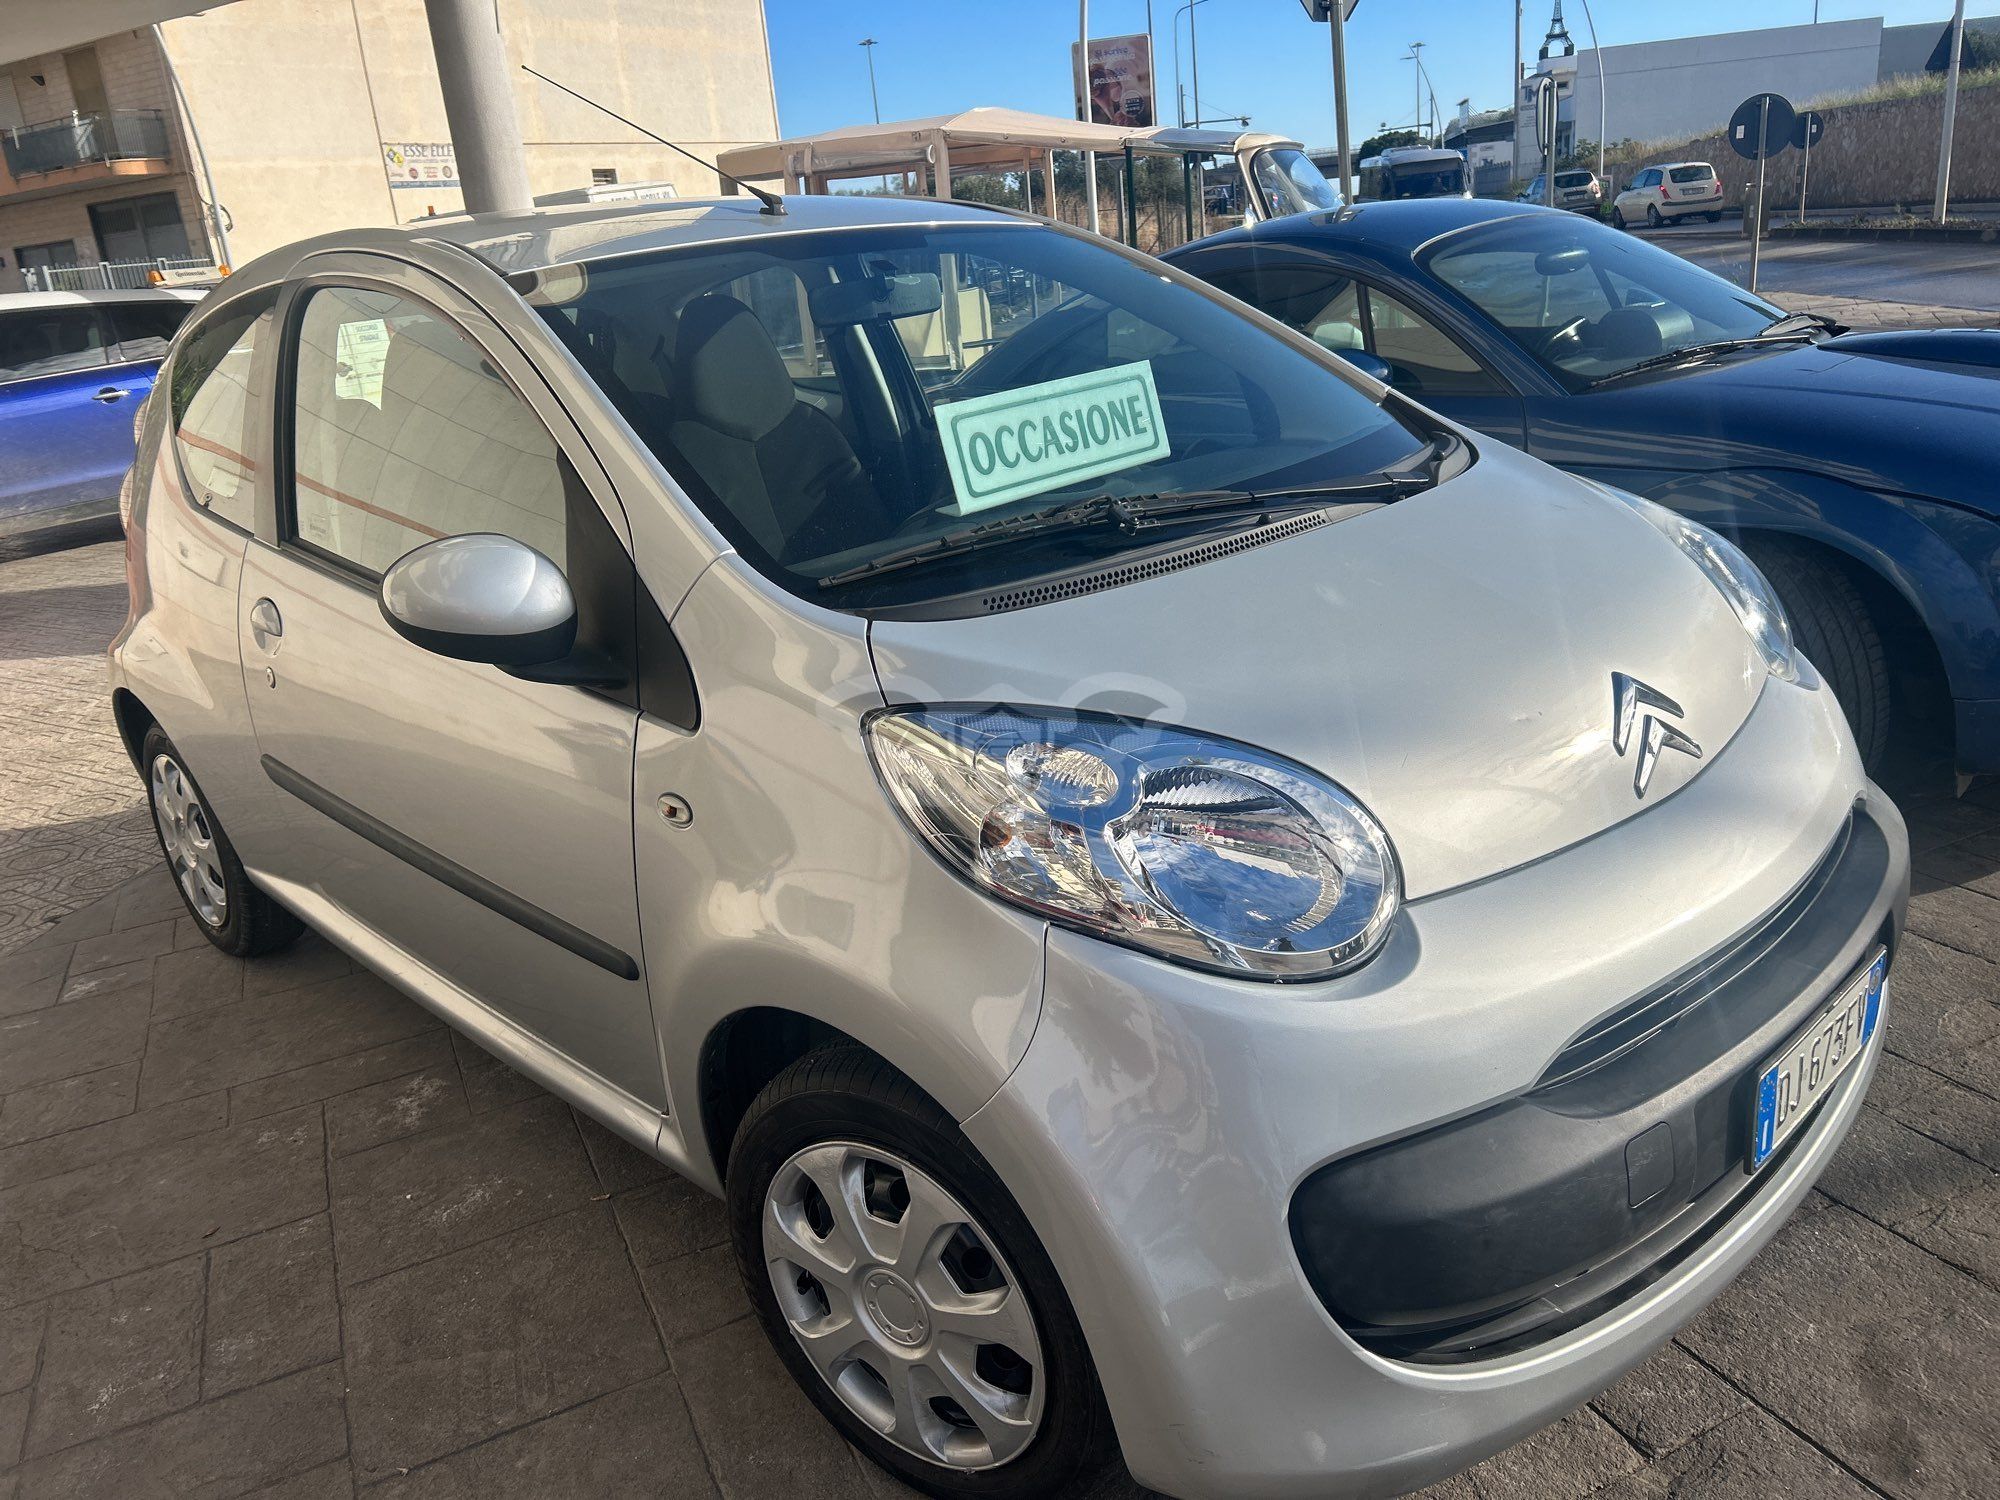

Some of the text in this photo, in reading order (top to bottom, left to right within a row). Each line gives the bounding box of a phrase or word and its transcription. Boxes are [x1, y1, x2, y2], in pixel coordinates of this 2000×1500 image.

[404, 144, 454, 157] ESSE ELLE
[969, 396, 1147, 475] OCCASIONE
